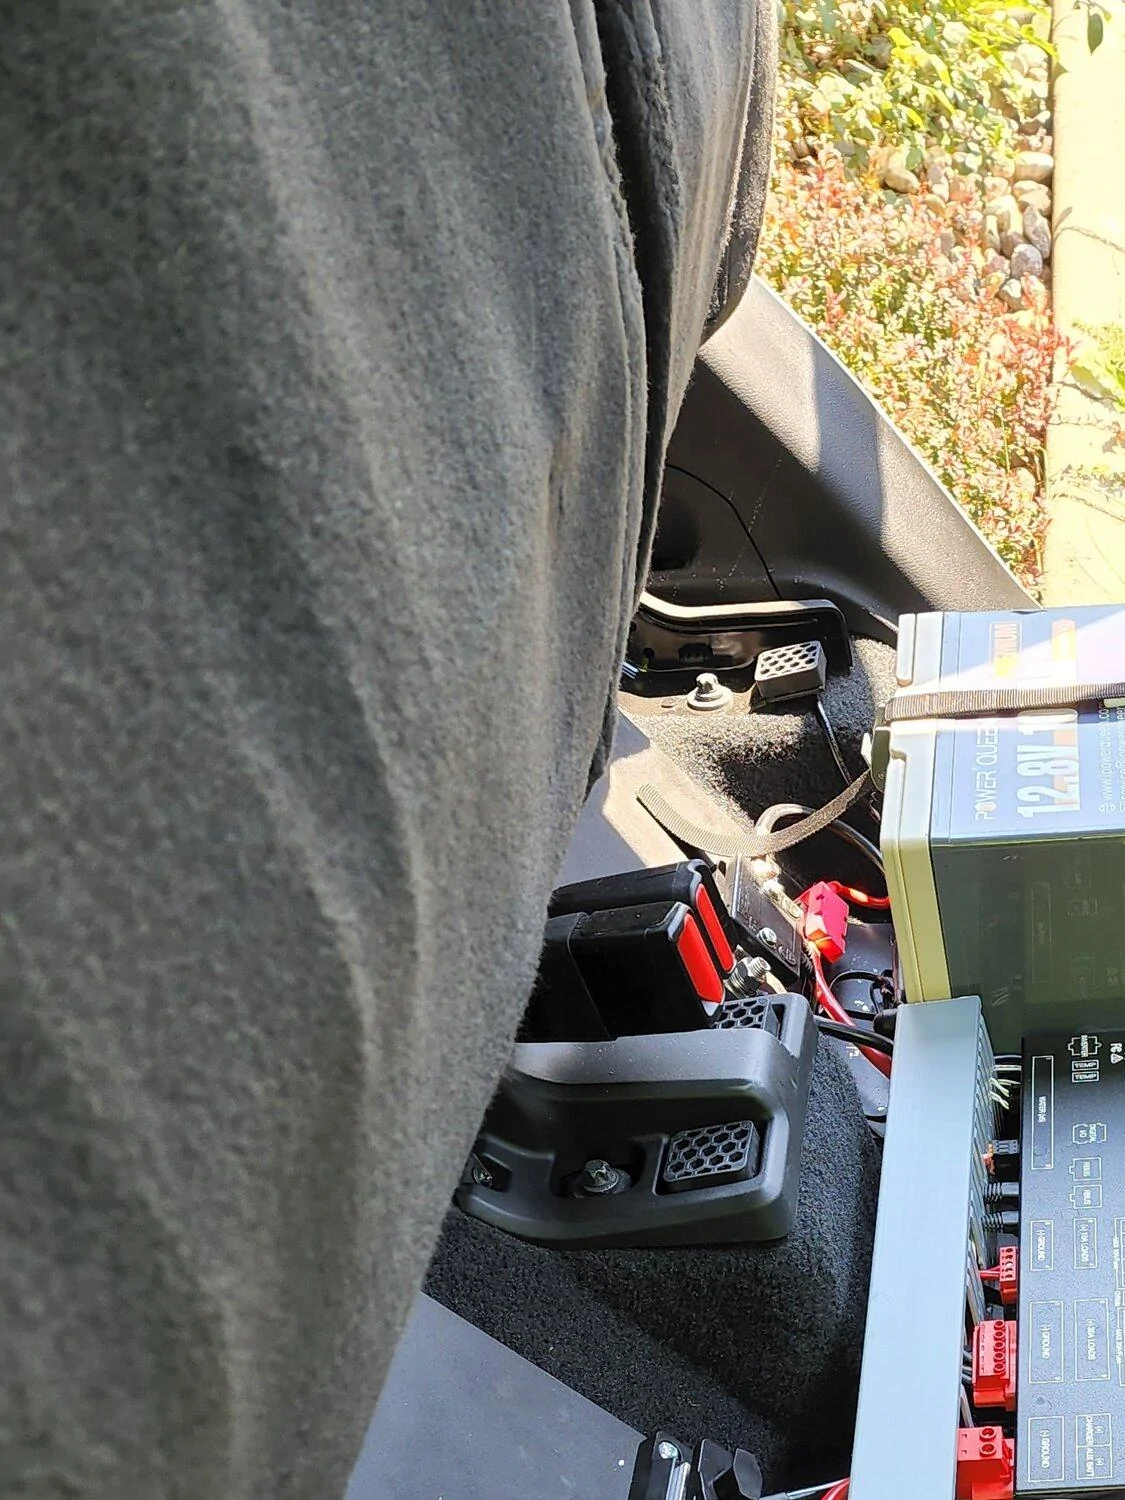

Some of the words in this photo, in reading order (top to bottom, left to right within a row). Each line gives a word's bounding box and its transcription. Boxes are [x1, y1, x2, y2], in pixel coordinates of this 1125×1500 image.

[974, 770, 997, 820] POWER
[1016, 744, 1080, 818] 12.8V
[1041, 1438, 1050, 1468] GROUND
